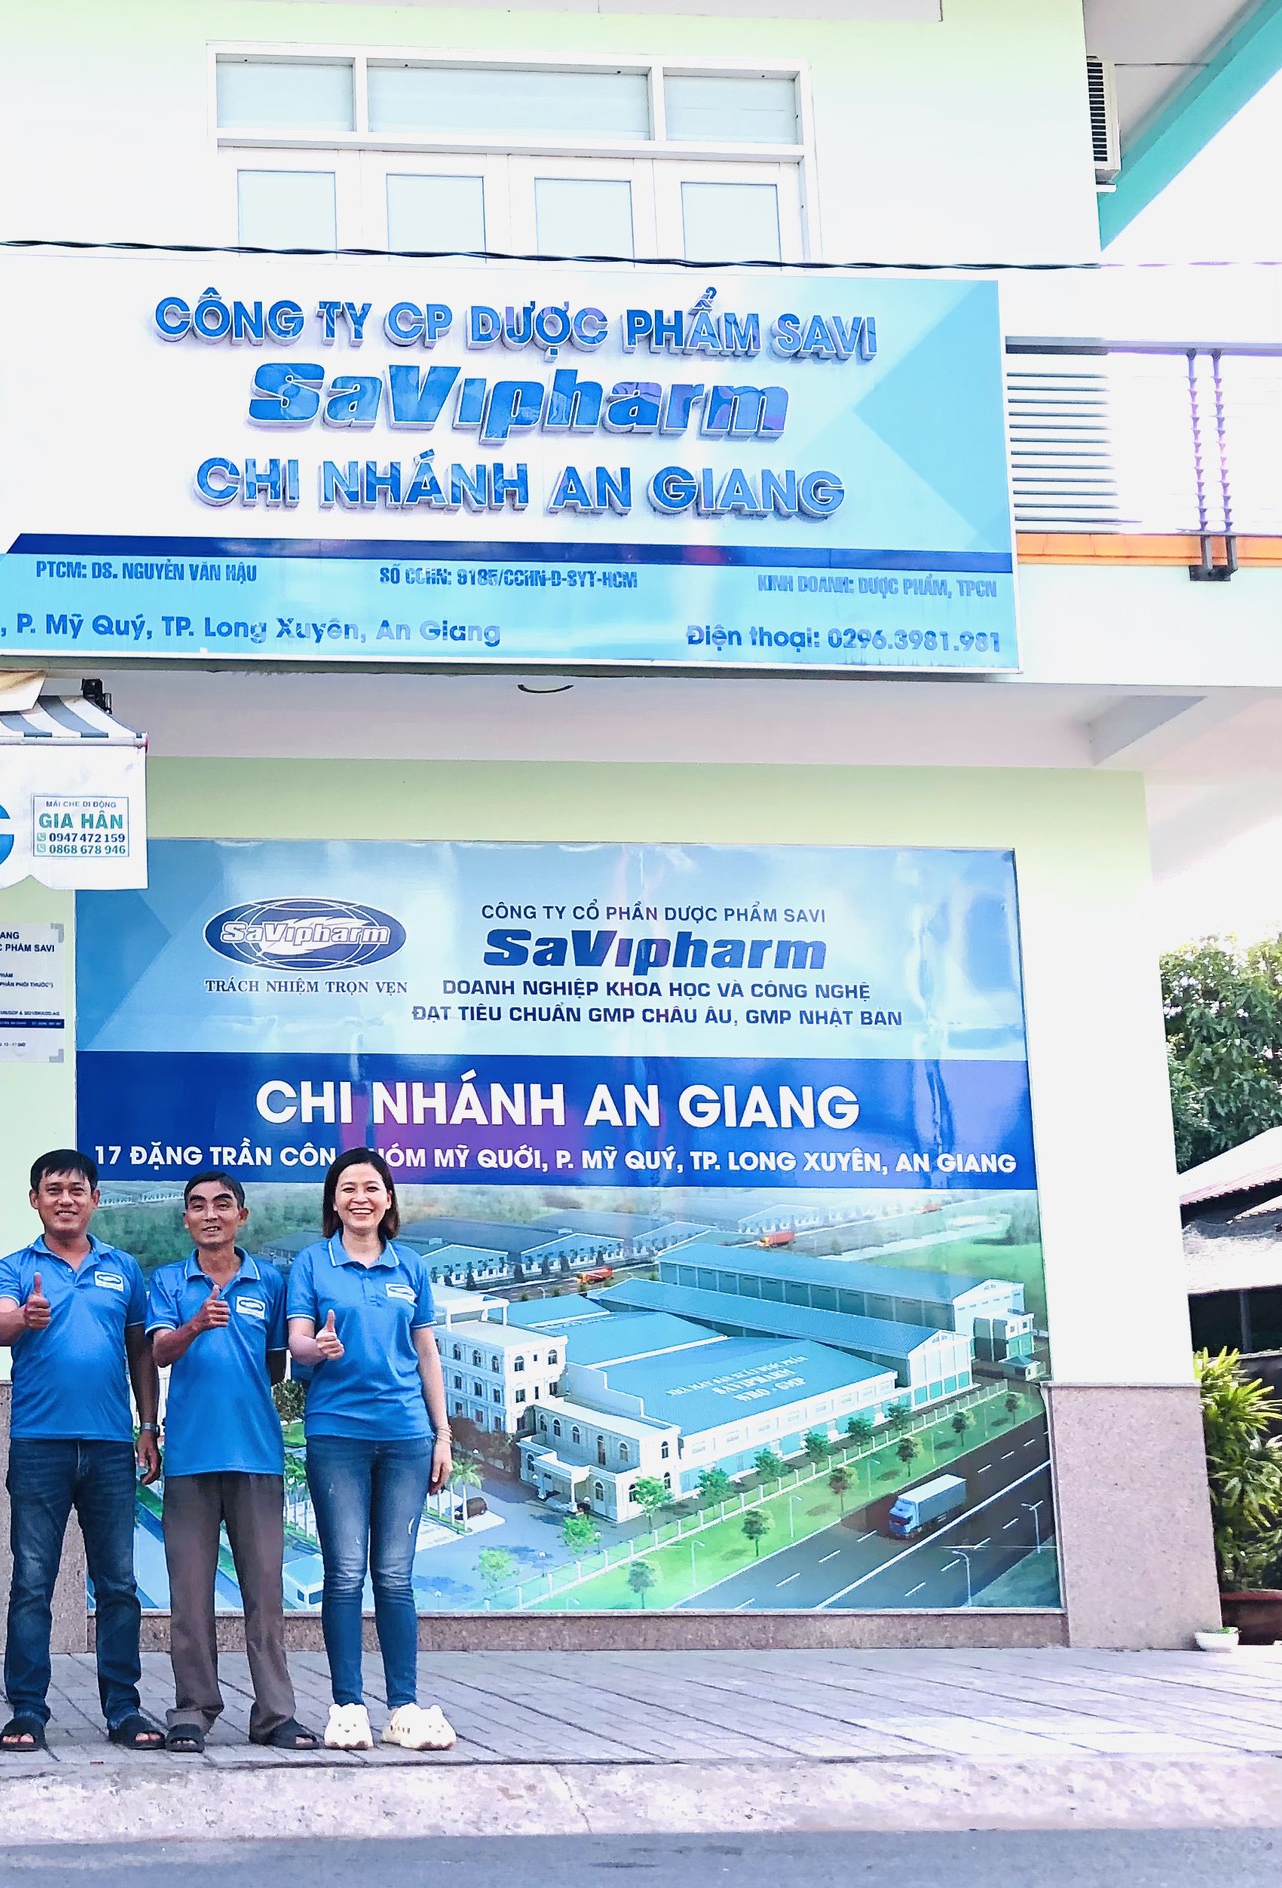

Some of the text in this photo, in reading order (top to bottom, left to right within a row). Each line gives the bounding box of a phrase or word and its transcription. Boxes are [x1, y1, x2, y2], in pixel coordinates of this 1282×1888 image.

[155, 286, 877, 360] CÔNG TY CP DƯỢC PHẨM SAVI
[194, 449, 845, 517] CHI NHÁNH AN GIANG
[36, 557, 257, 584] PTCM: DS. NGUYỄN VĂN HẬU
[379, 563, 401, 584] SỐ
[758, 574, 793, 592] KINH
[798, 575, 854, 593] DOANH:
[957, 580, 997, 597] TPCN
[17, 613, 35, 634] P.
[46, 613, 84, 640] Mỹ
[92, 613, 153, 641] Quý,
[162, 615, 195, 636] TP.
[204, 616, 267, 643] Long
[276, 616, 368, 645] Xuyên,
[376, 619, 411, 641] An
[420, 619, 502, 648] Giang
[686, 624, 1001, 652] Điện thoại: 0296.3981.981
[38, 809, 123, 829] GIA HÂN
[49, 832, 125, 843] 0947 472 159
[49, 844, 126, 854] 0868 678 946
[480, 897, 827, 925] CÔNG TY CỔ PHẦN DƯỢC PHẨM SAVI
[34, 944, 55, 952] SAVI
[205, 976, 408, 997] TRÁCH NHIỆM TRỌN VẸN
[442, 976, 871, 1002] DOANH NGHIỆP KHOA HỌC VÀ CÔNG NGHỆ
[411, 1005, 452, 1023] ĐẠT
[457, 1002, 503, 1022] TIÊU
[508, 1000, 582, 1023] CHUẨN
[587, 1006, 635, 1023] GMP
[641, 1003, 699, 1024] CHÂU
[704, 1003, 739, 1027] ÂU,
[745, 1008, 792, 1025] GMP
[798, 1006, 855, 1027] NHẬT
[255, 1068, 860, 1129] CHI NHÁNH AN GIANG
[95, 1145, 122, 1166] 17
[129, 1143, 203, 1171] ĐẶNG
[209, 1137, 273, 1167] TRẦN
[434, 1142, 470, 1168] MỸ
[476, 1143, 548, 1173] QUỚI,
[557, 1151, 574, 1169] P.
[581, 1145, 618, 1170] MỸ
[624, 1145, 684, 1173] QUÝ,
[690, 1150, 721, 1171] TP.
[728, 1151, 797, 1172] LONG
[803, 1147, 889, 1175] XUYÊN,
[895, 1153, 930, 1173] AN
[936, 1153, 1017, 1174] GIANG
